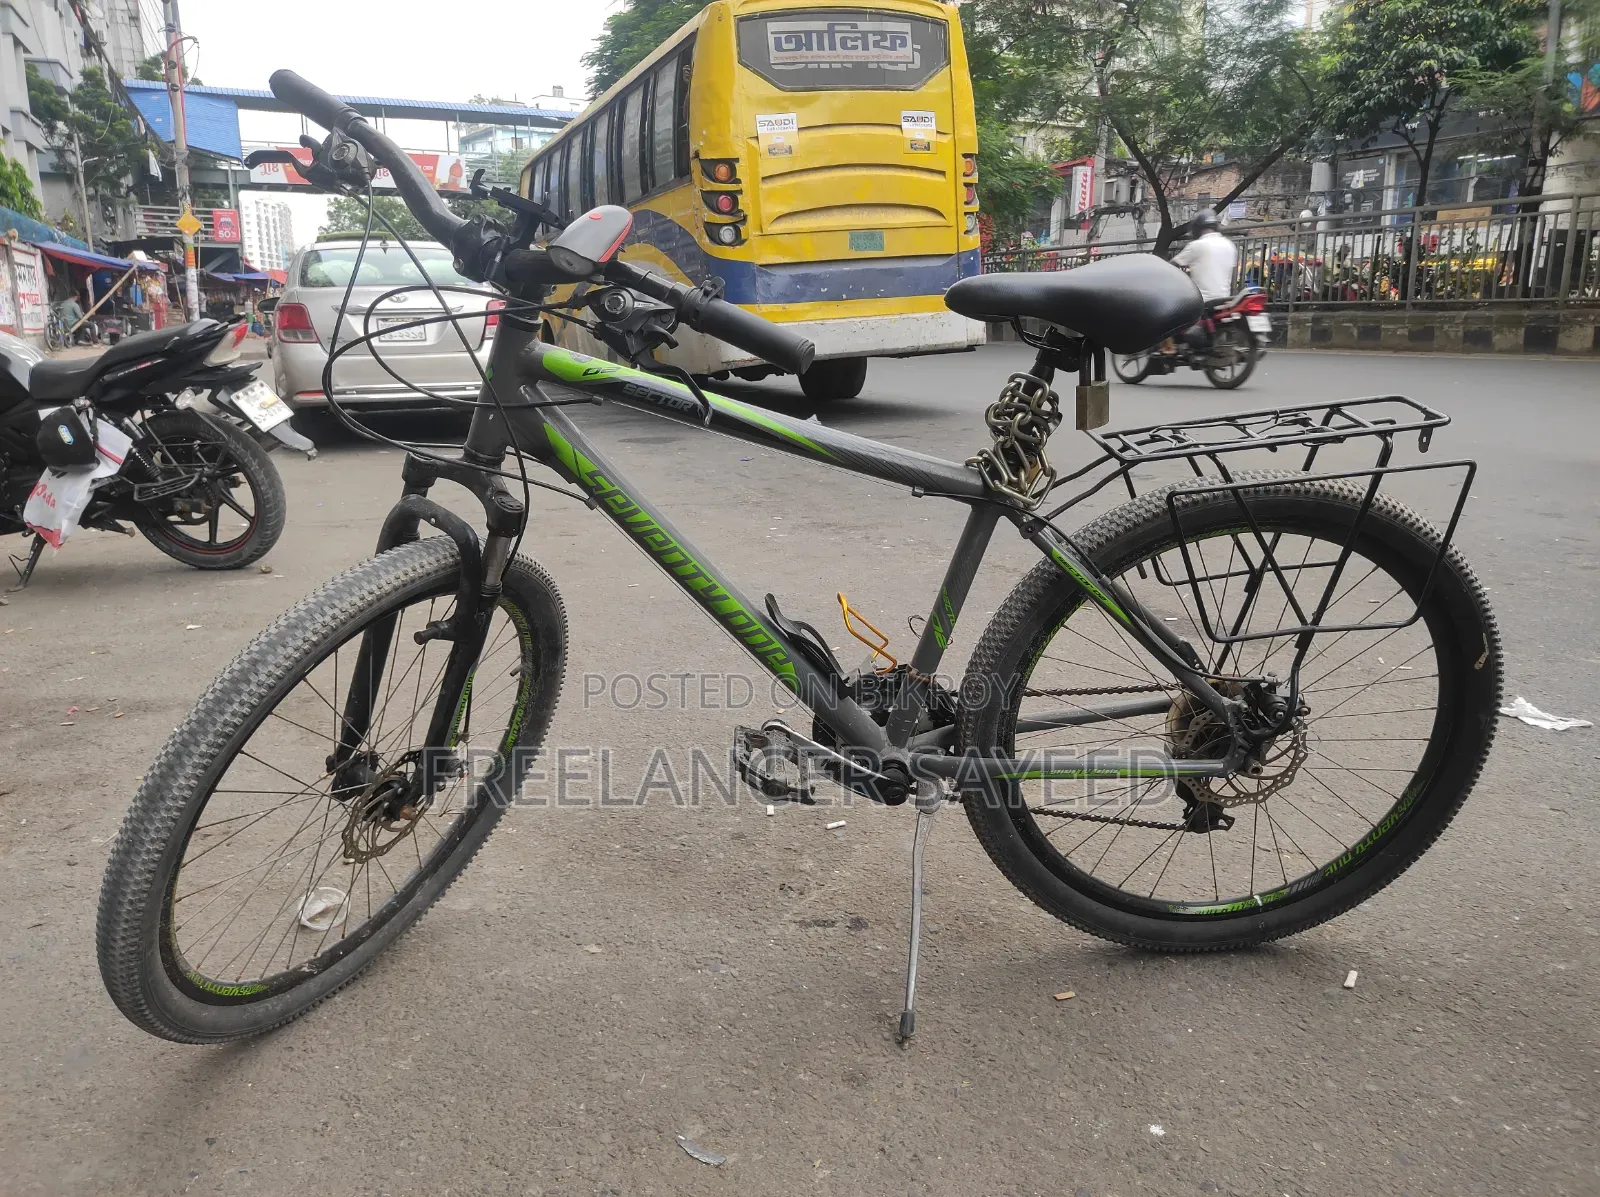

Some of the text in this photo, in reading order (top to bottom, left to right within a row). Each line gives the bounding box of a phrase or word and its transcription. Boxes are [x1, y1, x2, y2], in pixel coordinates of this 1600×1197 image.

[770, 23, 910, 52] আলিফ
[758, 119, 794, 127] SAUDI
[1078, 171, 1088, 212] Bata
[622, 383, 695, 412] SECTOR
[942, 586, 956, 628] SECTO
